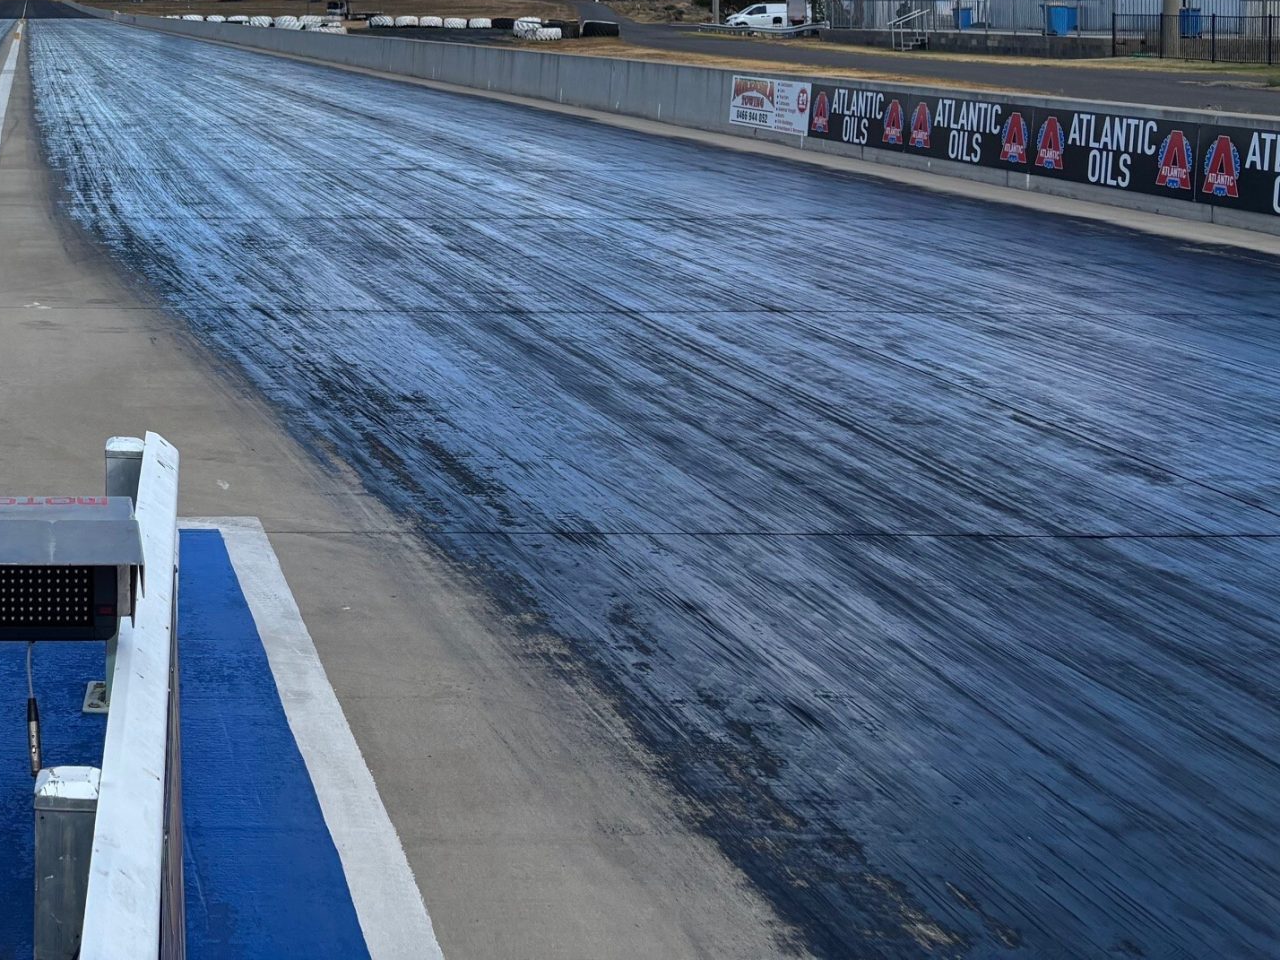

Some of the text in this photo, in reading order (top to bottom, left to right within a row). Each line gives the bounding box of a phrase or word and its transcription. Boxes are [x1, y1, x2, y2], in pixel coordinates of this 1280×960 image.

[831, 88, 884, 119] ATLANTIC
[934, 98, 1002, 135] ATLANTIC
[842, 115, 869, 145] OILS
[1067, 112, 1158, 155] ATLANTIC
[948, 130, 982, 163] OILS
[1087, 149, 1132, 188] OILS
[1161, 166, 1186, 179] ATLANTIC
[1208, 173, 1234, 186] ATLANTIC
